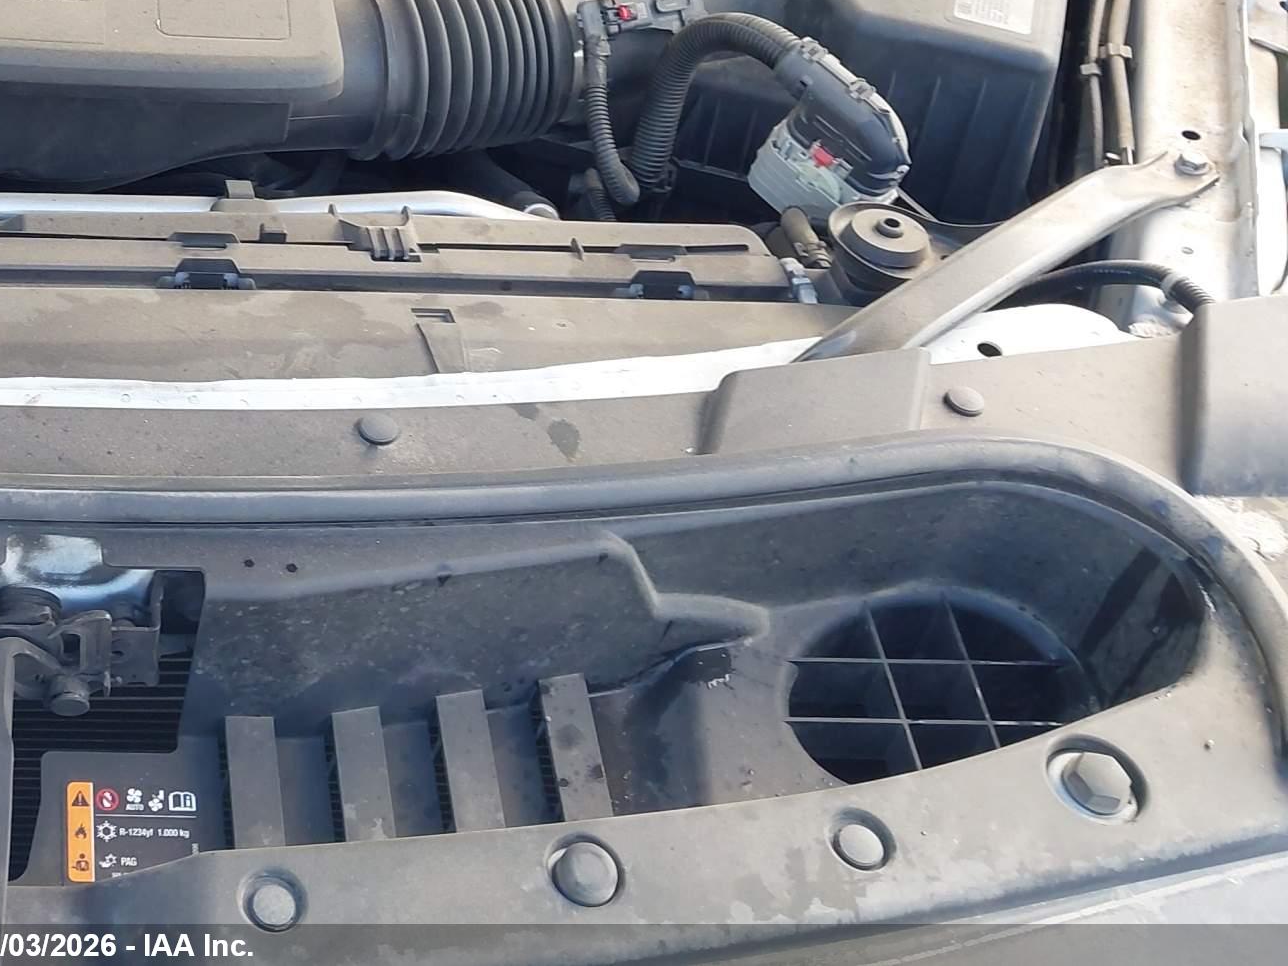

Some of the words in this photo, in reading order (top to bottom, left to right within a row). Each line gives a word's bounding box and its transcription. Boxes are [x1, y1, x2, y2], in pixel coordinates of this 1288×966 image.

[125, 803, 144, 811] AUTO
[119, 827, 153, 838] R-1234yf
[179, 828, 190, 838] kg
[120, 856, 137, 866] PAG
